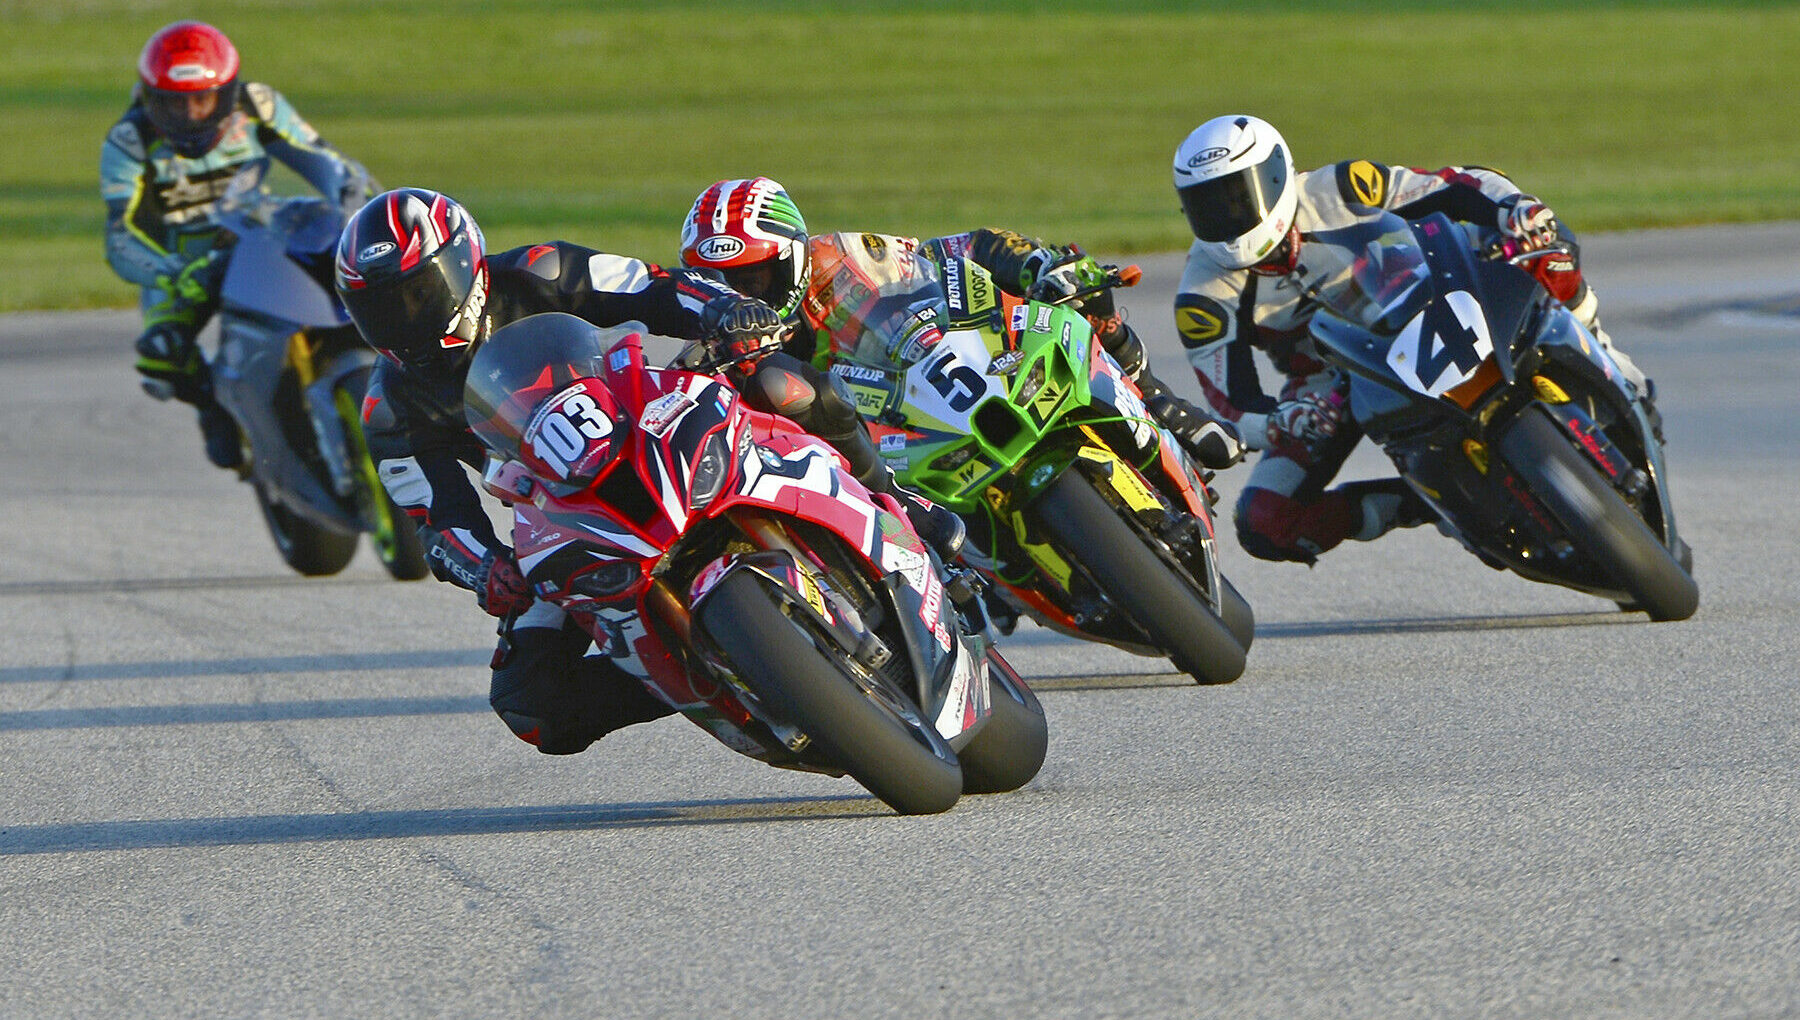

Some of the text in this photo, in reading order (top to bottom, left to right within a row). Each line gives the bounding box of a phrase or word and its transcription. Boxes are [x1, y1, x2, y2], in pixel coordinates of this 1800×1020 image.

[363, 244, 390, 259] HJC
[702, 238, 738, 256] Arai
[946, 257, 961, 310] DUNLOP
[1415, 294, 1483, 391] 4
[830, 363, 885, 382] DUNLOP
[992, 352, 1015, 371] 124
[925, 353, 987, 413] 5
[533, 393, 614, 481] 103
